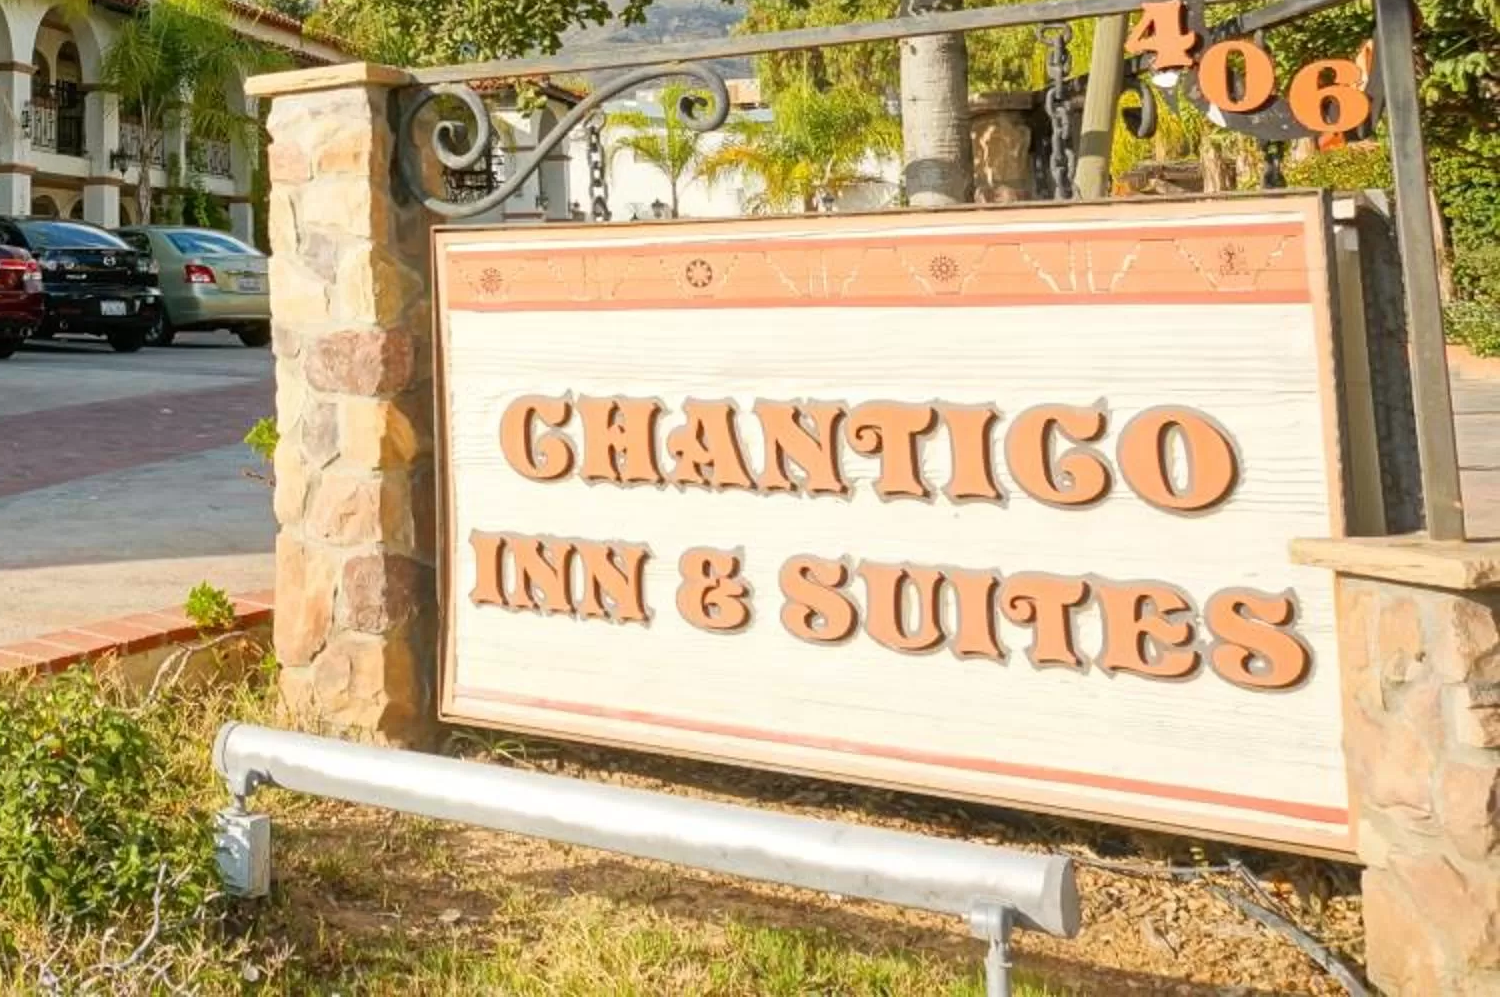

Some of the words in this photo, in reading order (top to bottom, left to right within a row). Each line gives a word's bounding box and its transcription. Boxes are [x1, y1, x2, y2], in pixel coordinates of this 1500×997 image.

[499, 391, 1243, 516] CHANTICO
[469, 530, 654, 628] INN
[677, 546, 751, 633] &
[779, 553, 1315, 693] SUITES
